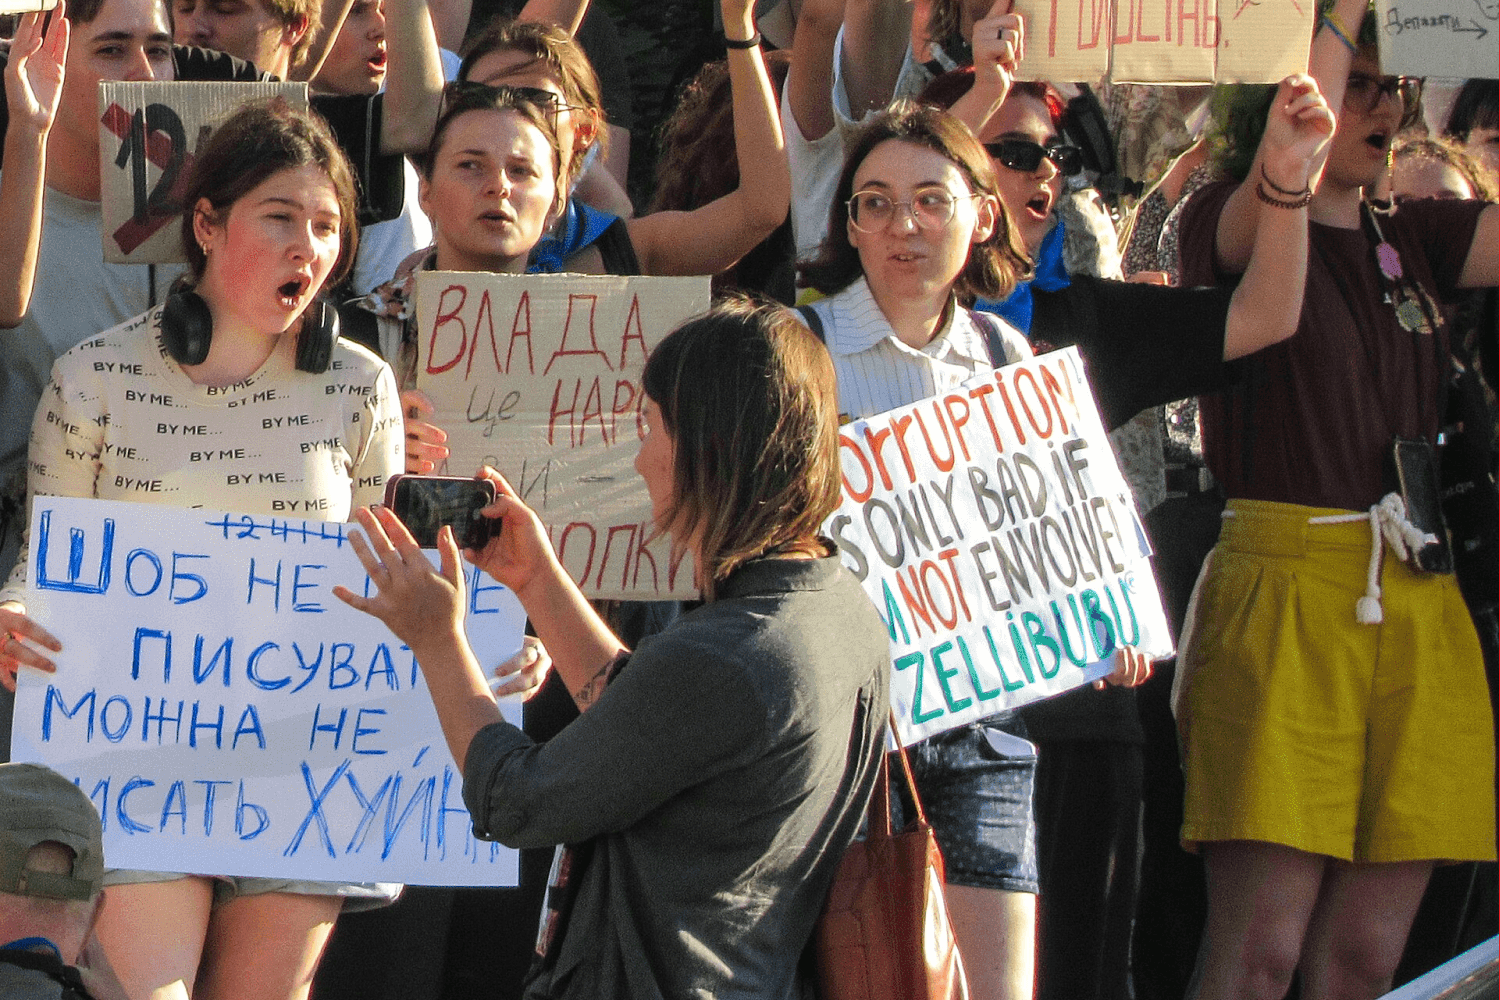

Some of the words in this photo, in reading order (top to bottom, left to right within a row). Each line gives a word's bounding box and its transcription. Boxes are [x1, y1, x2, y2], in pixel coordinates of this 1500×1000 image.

[426, 284, 650, 381] ВЛАДА
[93, 361, 116, 373] BY
[126, 389, 147, 402] BY
[206, 385, 230, 396] BY
[325, 383, 347, 395] BY
[157, 422, 180, 435] BY
[261, 416, 284, 430] BY
[300, 440, 321, 454] BY
[189, 451, 215, 462] BY
[114, 475, 135, 490] BY
[227, 473, 253, 485] BY
[272, 499, 300, 512] BY
[862, 474, 964, 569] ONLY
[968, 451, 1048, 532] BAD
[549, 521, 700, 596] ОПКИ
[246, 556, 328, 614] НЕ
[895, 548, 972, 639] NOT
[132, 625, 420, 694] ПИСУВАТ
[41, 685, 266, 751] МОЖНА
[309, 706, 389, 755] НЕ
[283, 746, 501, 864] ХУЙН
